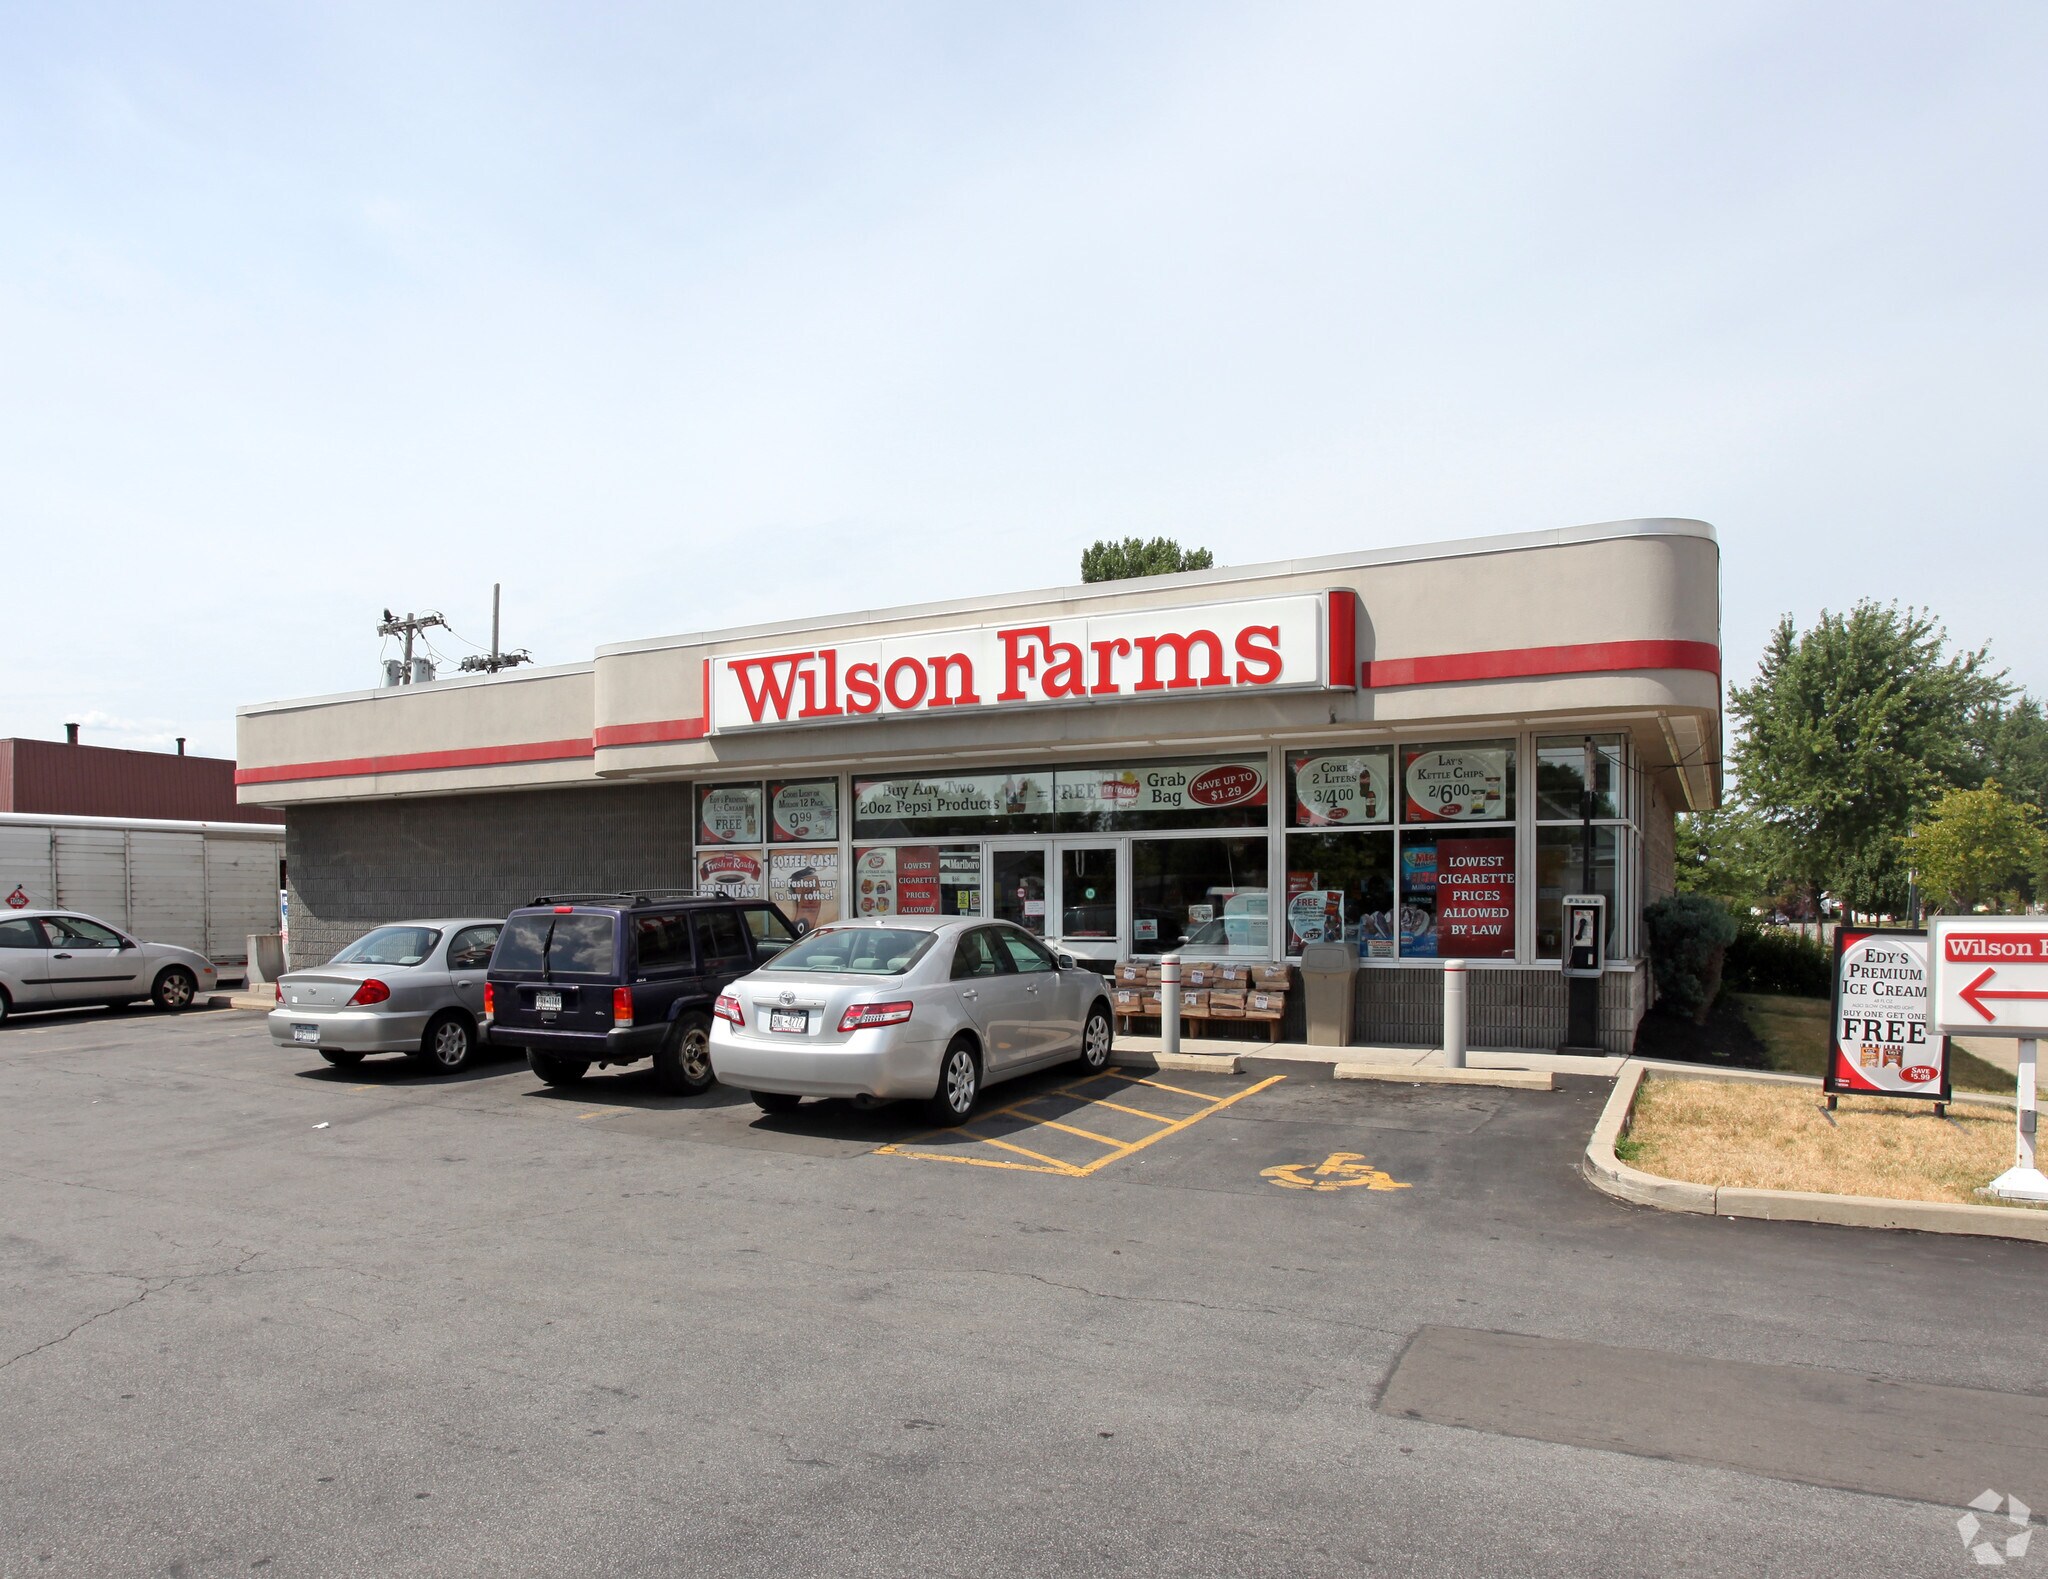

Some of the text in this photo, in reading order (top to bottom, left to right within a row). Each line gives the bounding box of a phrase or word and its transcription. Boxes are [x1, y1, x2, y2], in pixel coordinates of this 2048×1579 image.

[727, 625, 1284, 723] Wilson Farms
[1147, 772, 1187, 788] Grab
[1196, 772, 1253, 791] SAVE UP TO
[1312, 774, 1320, 784] 2
[882, 779, 976, 800] Buy Any Two
[1053, 782, 1098, 799] FREE
[1211, 786, 1242, 801] $1.29
[1152, 788, 1182, 806] Bag
[860, 797, 1000, 817] 20oz Pepsi Products
[715, 819, 742, 830] FREE
[771, 853, 838, 868] COFFEE CASH
[904, 862, 932, 870] LOWEST
[950, 859, 980, 870] Marlboro
[1449, 856, 1505, 868] LOWEST
[770, 879, 785, 889] The
[818, 879, 837, 890] way
[1438, 873, 1515, 885] CIGARETTE
[775, 890, 834, 902] to buy coffee!
[906, 891, 931, 899] PRICES
[1452, 890, 1501, 902] PRICES
[1296, 898, 1319, 906] FREE
[901, 906, 936, 914] ALLOWED
[1443, 907, 1510, 919] ALLOWED
[1451, 924, 1502, 936] BY LAW
[1948, 938, 2034, 956] Wilson
[1864, 948, 1909, 964] EDY'S
[1849, 963, 1923, 981] PREMIUM
[1842, 979, 1927, 998] ICE CREAM
[1843, 1009, 1862, 1017] BUY
[1864, 1010, 1884, 1018] ONE
[1842, 1018, 1928, 1044] FREE
[1911, 1067, 1931, 1075] SAVE
[1911, 1073, 1931, 1081] $5.99
